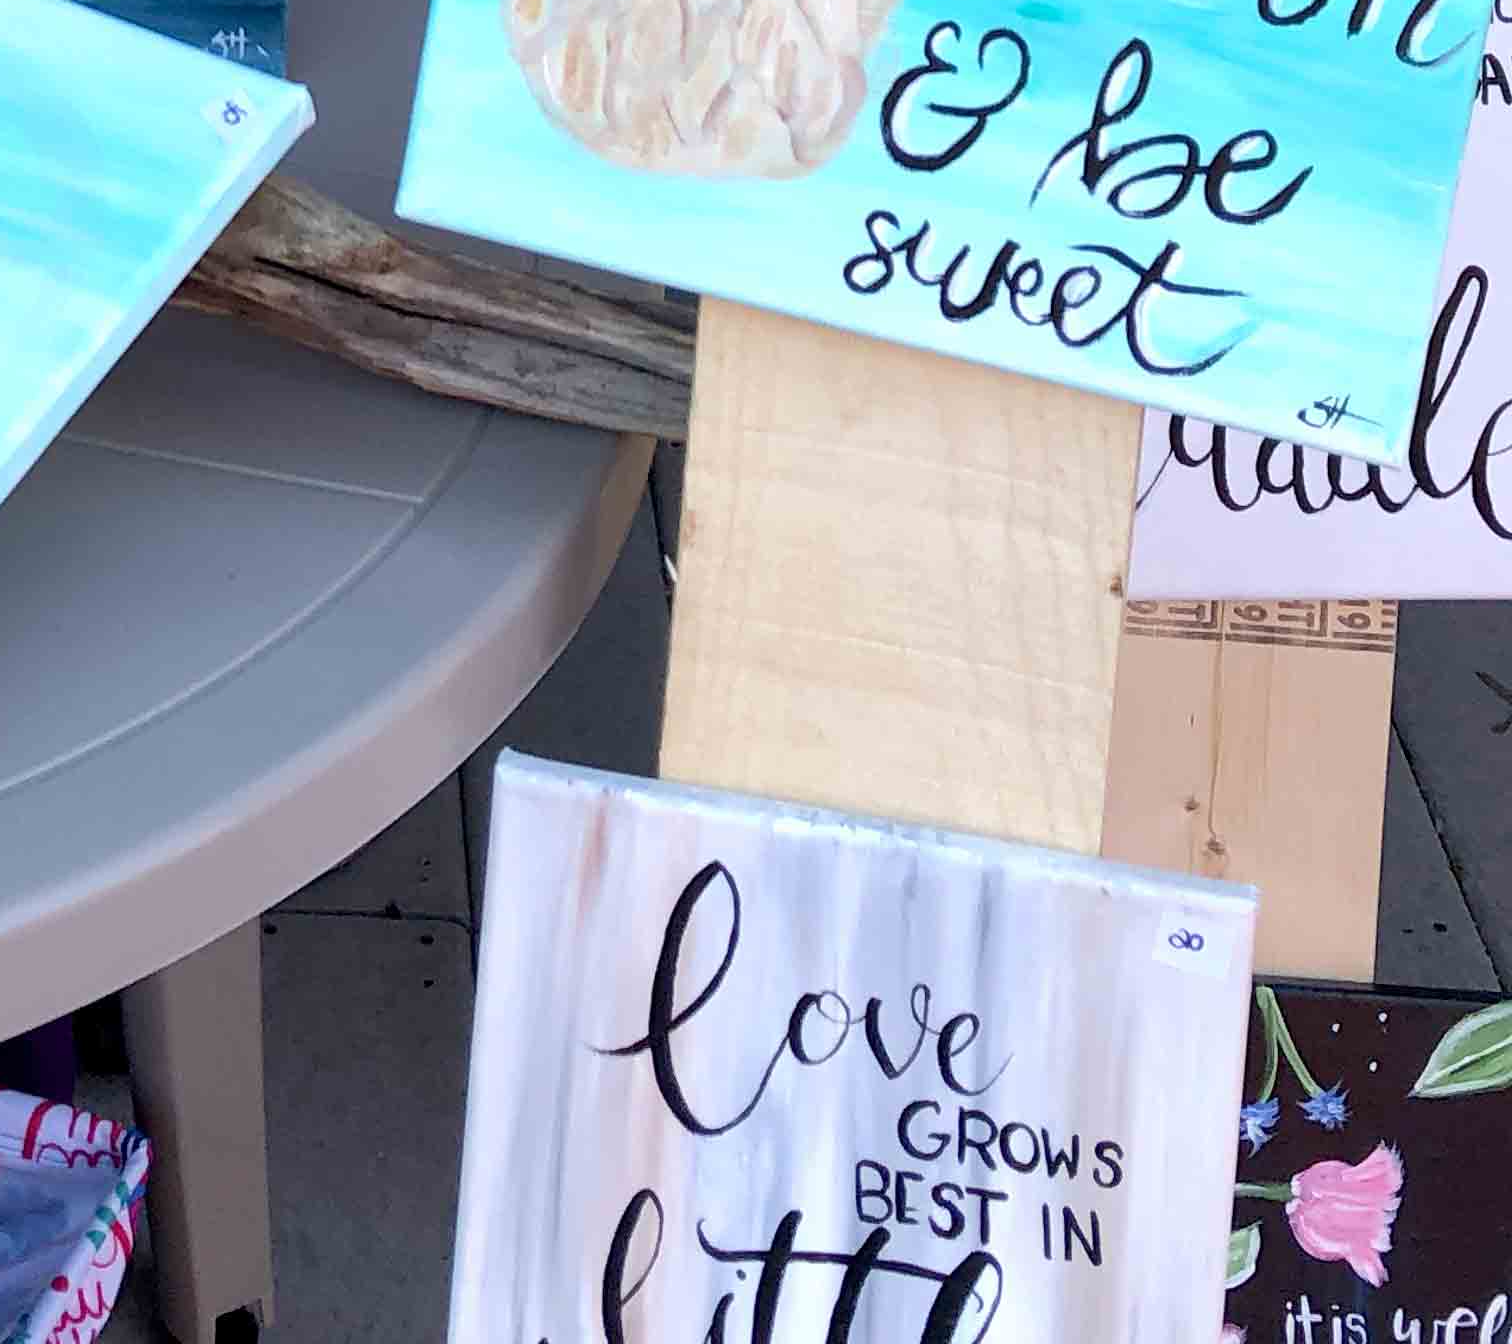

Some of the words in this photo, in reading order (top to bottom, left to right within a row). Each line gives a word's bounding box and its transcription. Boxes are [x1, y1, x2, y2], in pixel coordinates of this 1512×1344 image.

[879, 20, 1031, 172] &
[1029, 38, 1314, 226] be
[843, 209, 1254, 377] sweet
[586, 858, 1016, 1138] love
[1167, 927, 1205, 952] 20
[897, 1100, 1126, 1190] GROWS
[854, 1160, 1008, 1247] BEST
[1039, 1203, 1104, 1269] IN
